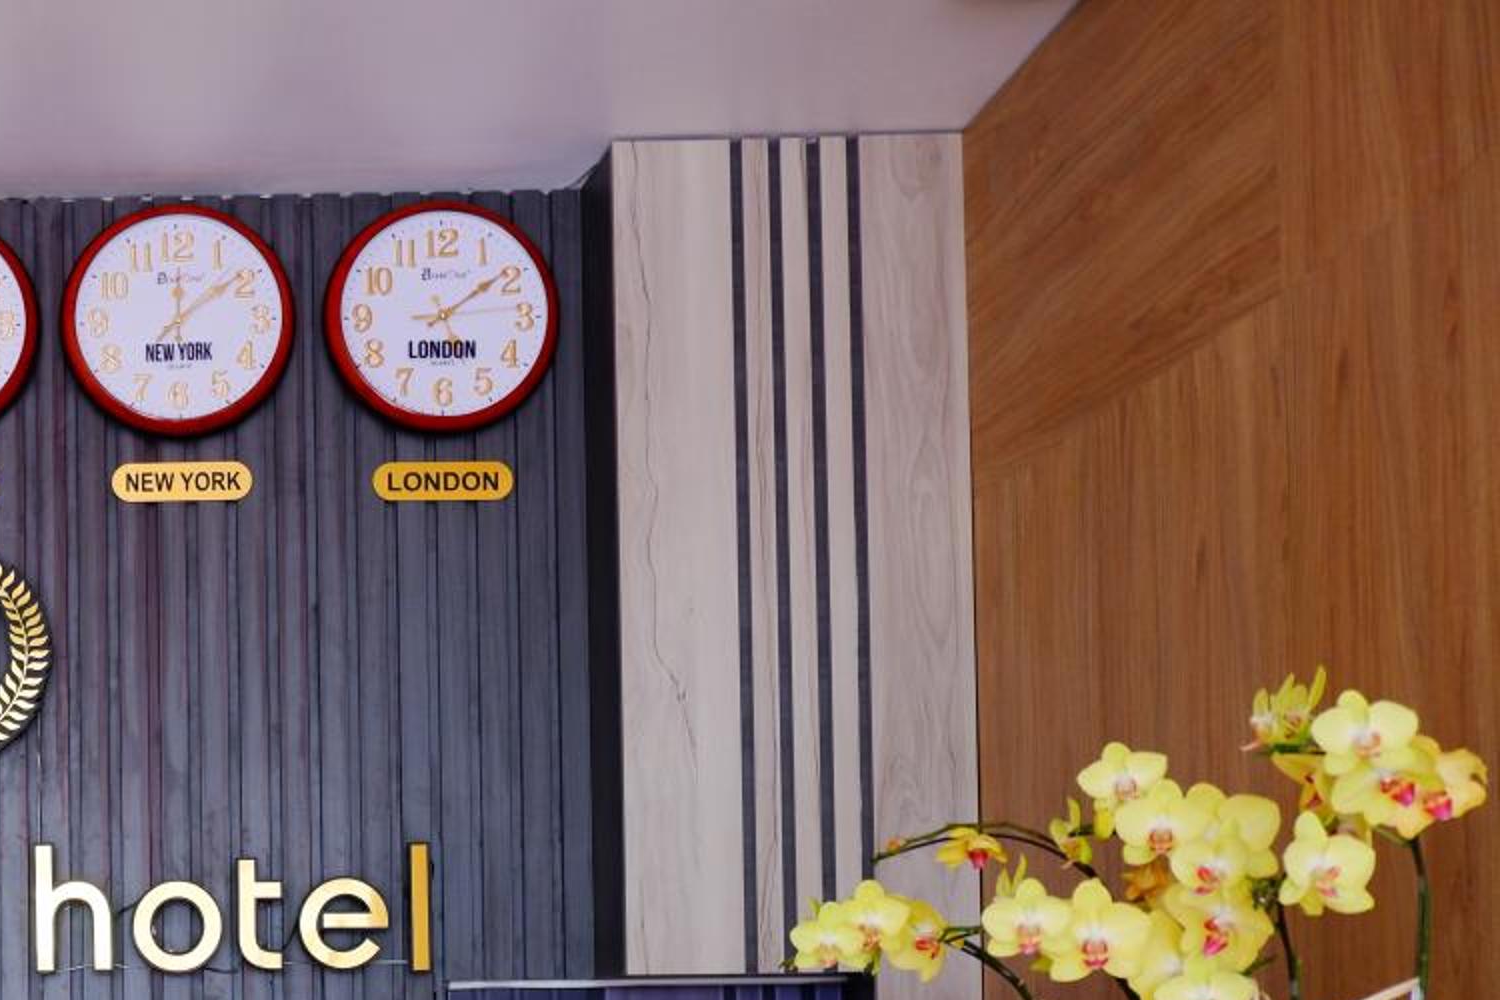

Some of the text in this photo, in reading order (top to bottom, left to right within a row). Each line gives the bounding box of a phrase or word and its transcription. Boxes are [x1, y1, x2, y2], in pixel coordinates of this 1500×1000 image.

[161, 231, 194, 262] 12
[212, 240, 224, 270] 1
[395, 239, 416, 268] 11
[425, 228, 458, 258] 12
[478, 237, 487, 266] 1
[130, 243, 153, 273] 11
[101, 272, 129, 300] 10
[235, 269, 255, 298] 2
[365, 267, 393, 296] 10
[501, 266, 521, 295] 2
[87, 308, 109, 337] 9
[251, 304, 271, 333] 3
[352, 304, 372, 332] 9
[516, 303, 534, 331] 3
[100, 345, 122, 374] 8
[145, 342, 212, 362] NEW YORK
[237, 340, 256, 370] 4
[364, 340, 385, 368] 8
[408, 341, 476, 359] LONDON
[501, 340, 519, 368] 4
[133, 373, 153, 401] 7
[168, 381, 189, 410] 6
[212, 371, 230, 398] 5
[395, 367, 414, 396] 7
[433, 377, 453, 407] 6
[474, 368, 493, 396] 5
[125, 472, 241, 492] NEW YORK
[387, 472, 499, 491] LONDON
[33, 841, 433, 974] hotel
